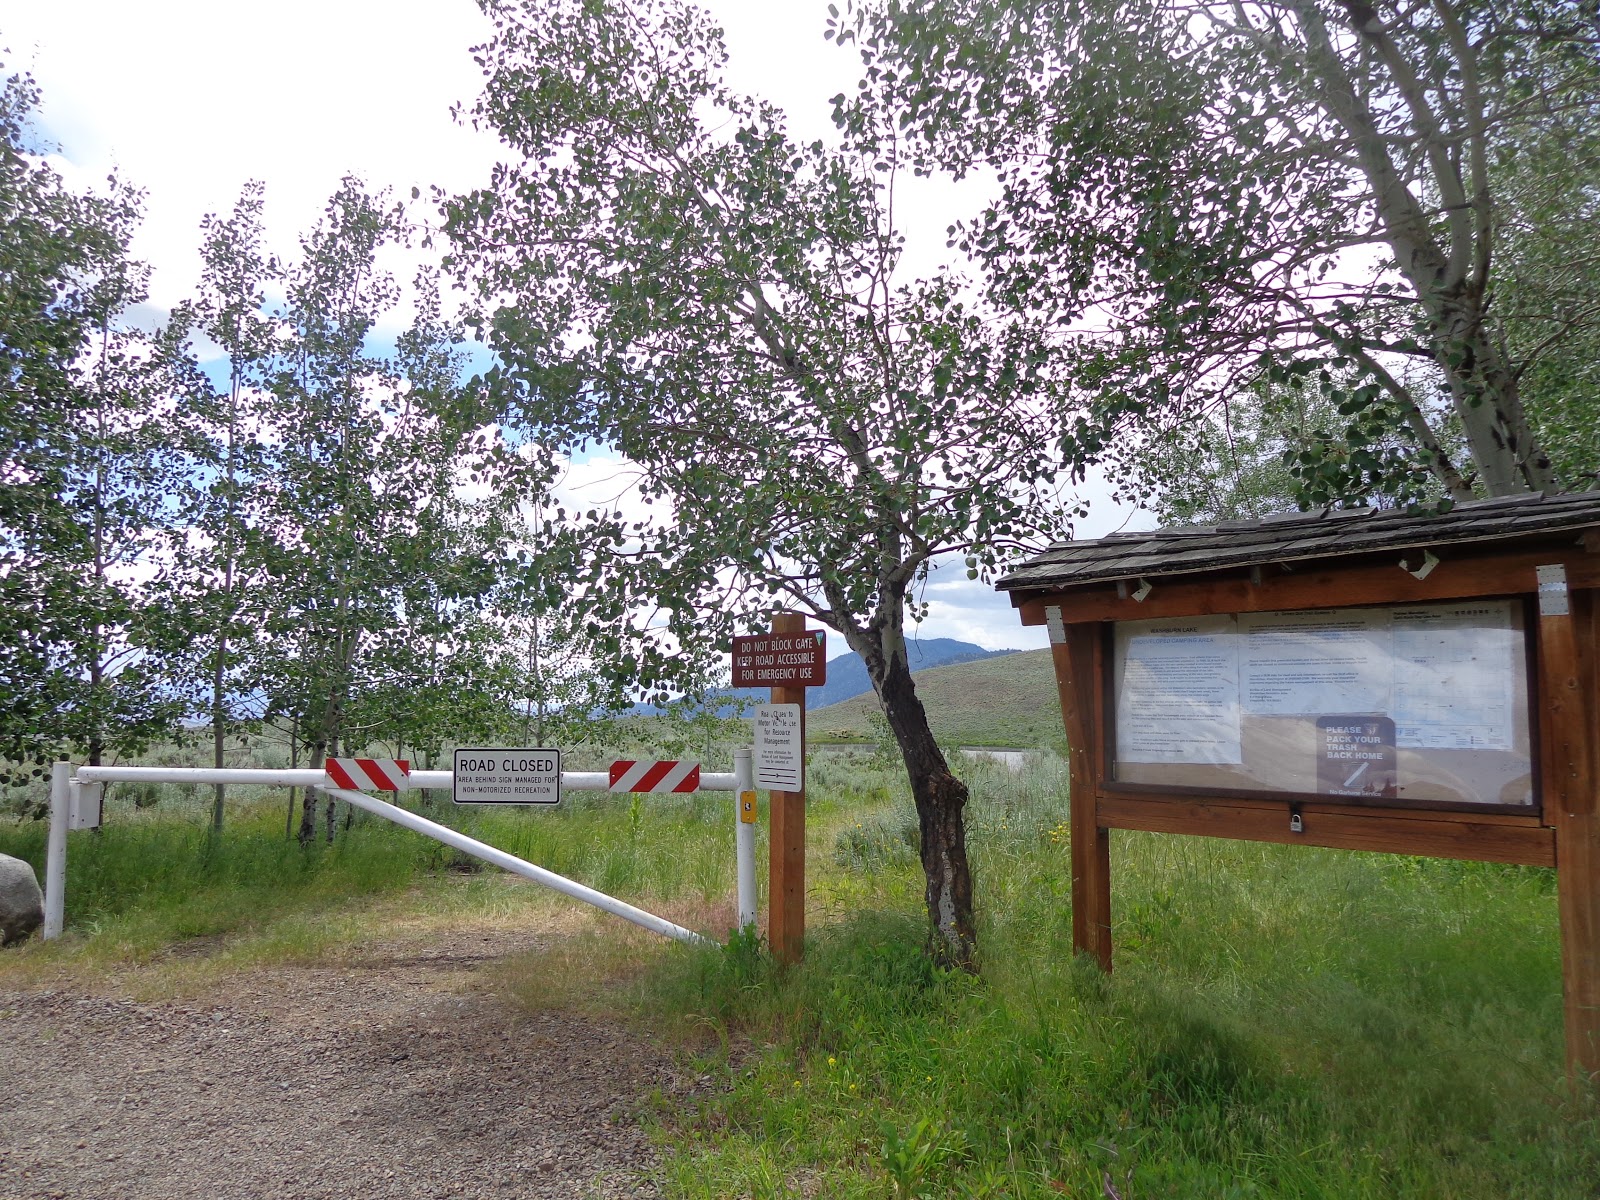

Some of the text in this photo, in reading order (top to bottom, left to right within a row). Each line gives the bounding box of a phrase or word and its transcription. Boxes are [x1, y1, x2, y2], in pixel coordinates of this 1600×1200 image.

[741, 637, 813, 653] DO NOT BLOCK GATE
[737, 652, 815, 667] KEEP ROAD ACCESSIBLE
[741, 667, 813, 681] FOR EMERGENCY USE
[772, 728, 791, 736] Resource
[1326, 726, 1362, 734] PLEASE
[764, 737, 791, 746] Management
[1326, 735, 1381, 744] PACK YOUR
[1326, 743, 1357, 751] TRASH
[1327, 751, 1383, 760] BACK HOME
[460, 759, 554, 772] ROAD CLOSED
[514, 776, 542, 784] MANAGED
[462, 786, 551, 794] NON-MOTORIZED RECREATION
